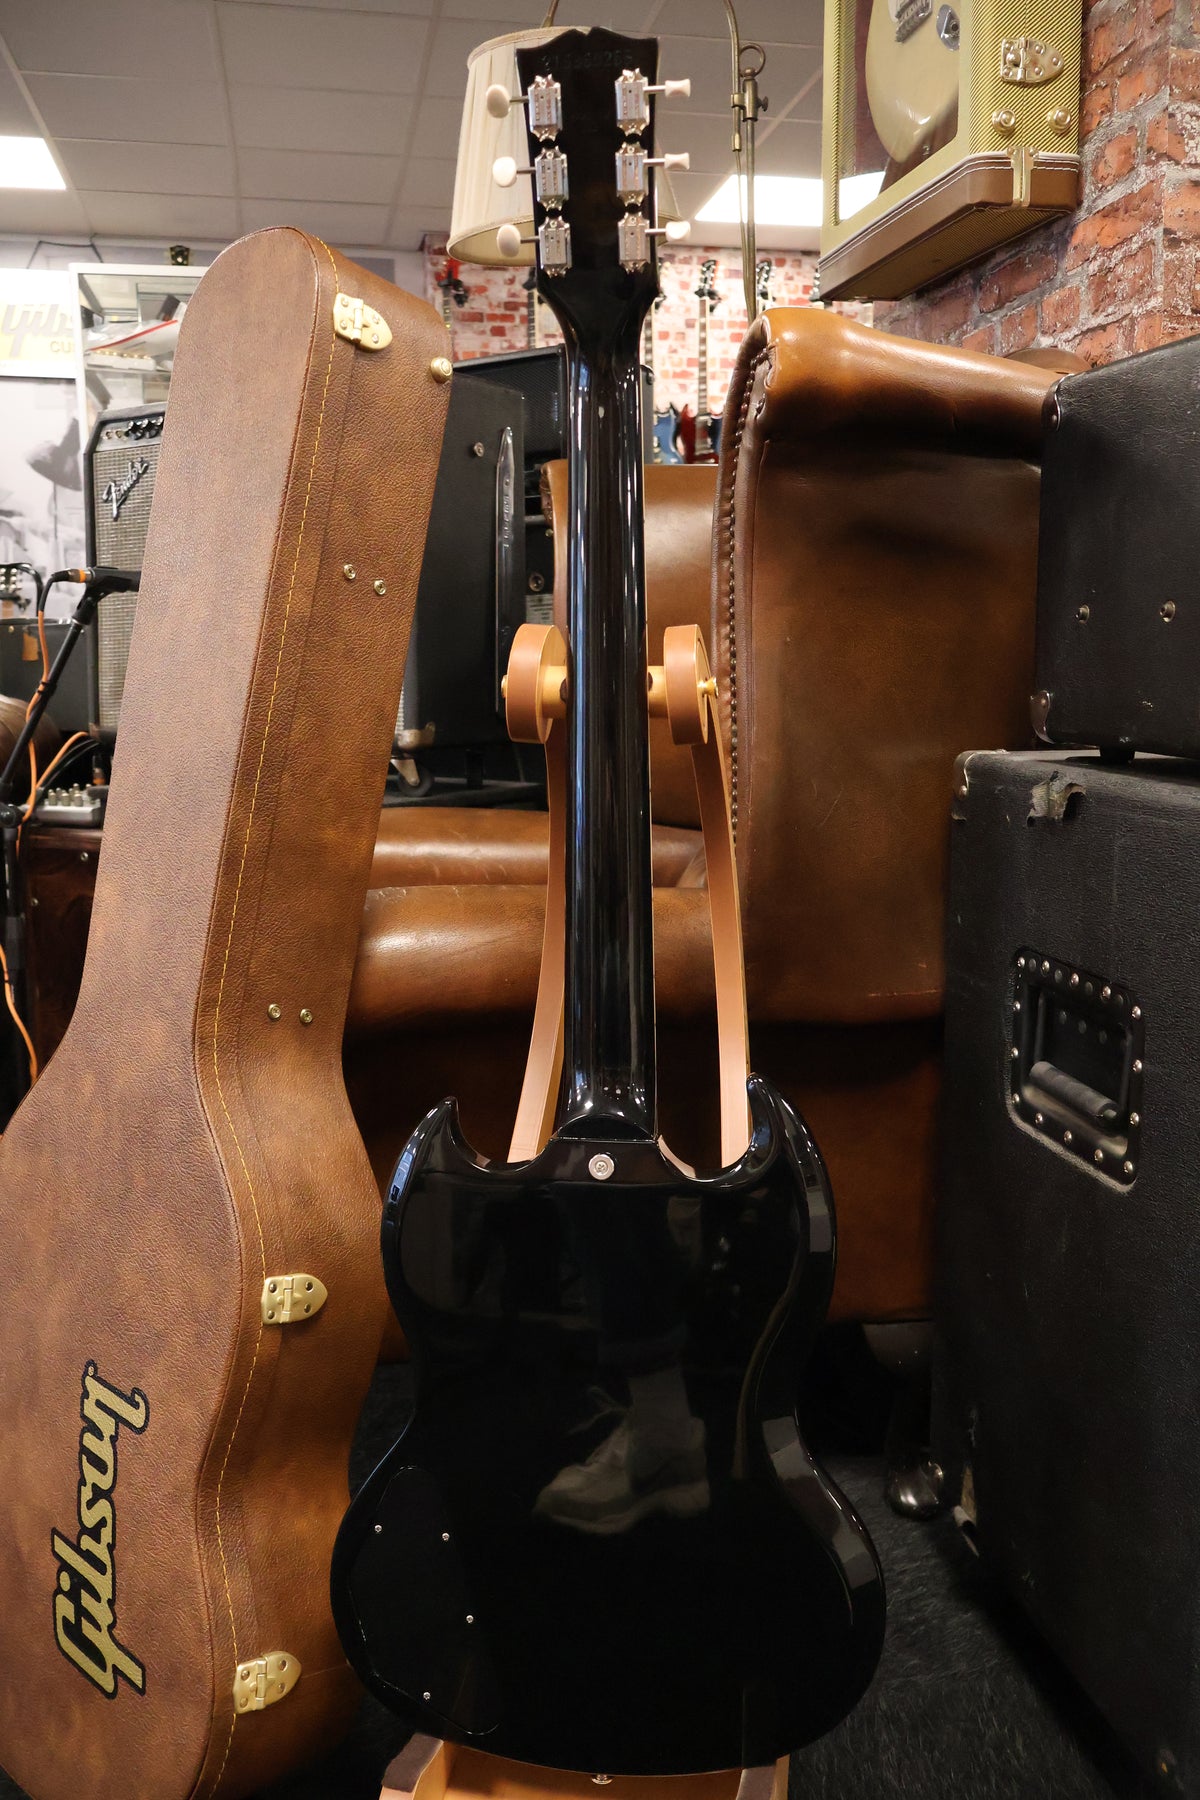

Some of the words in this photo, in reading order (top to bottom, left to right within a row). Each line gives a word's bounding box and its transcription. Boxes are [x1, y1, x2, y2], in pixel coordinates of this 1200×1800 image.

[50, 341, 75, 353] CU
[102, 458, 148, 521] Fender
[51, 1359, 150, 1699] Gibson
